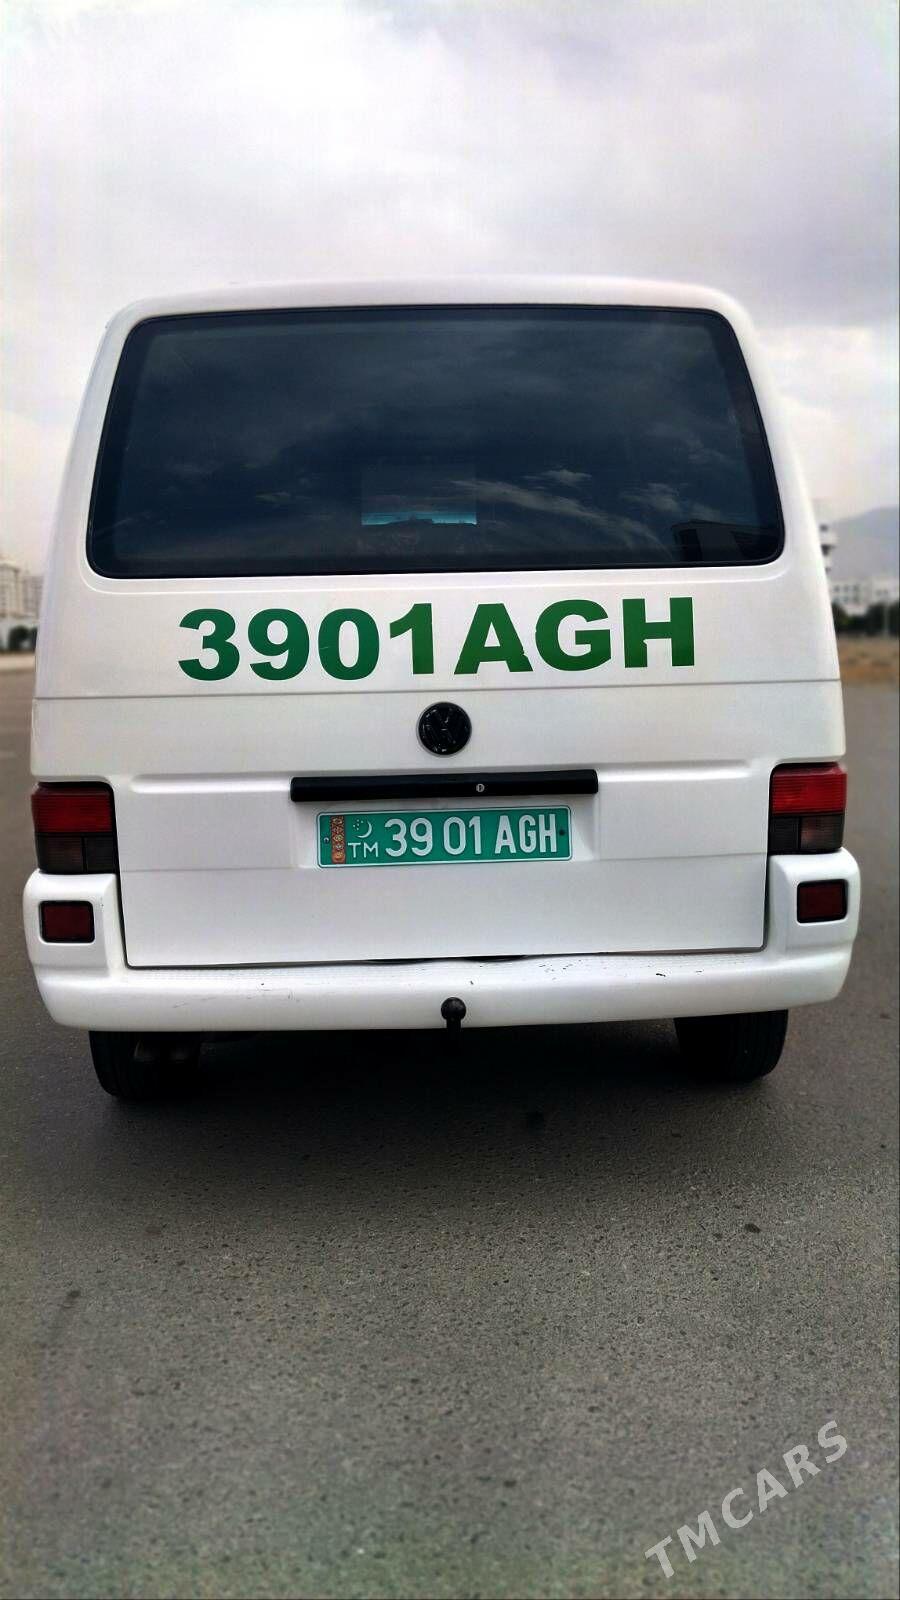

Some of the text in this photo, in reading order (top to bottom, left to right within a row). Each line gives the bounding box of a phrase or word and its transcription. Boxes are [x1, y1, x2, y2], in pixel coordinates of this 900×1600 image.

[178, 597, 695, 681] 3901AGH
[347, 813, 557, 858] TM 39 01 AGH
